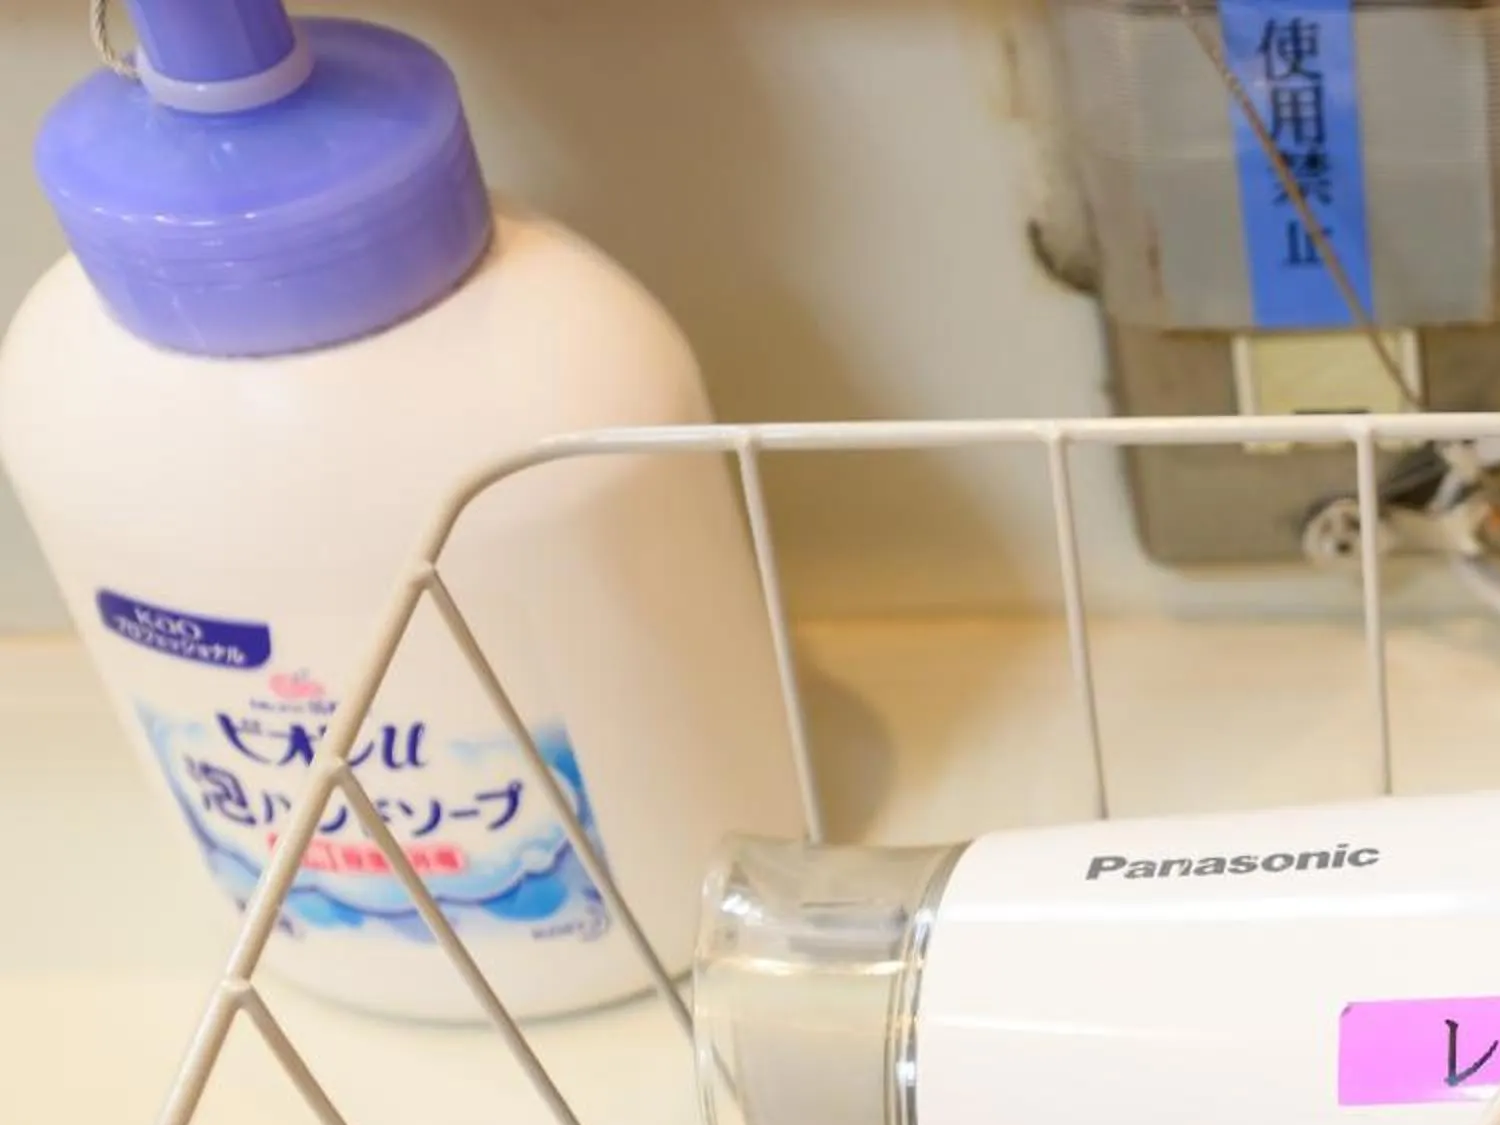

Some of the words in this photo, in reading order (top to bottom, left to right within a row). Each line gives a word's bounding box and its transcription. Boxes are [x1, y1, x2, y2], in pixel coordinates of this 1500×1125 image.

[1257, 17, 1334, 267] 使用禁止
[1085, 843, 1380, 880] Panasonic
